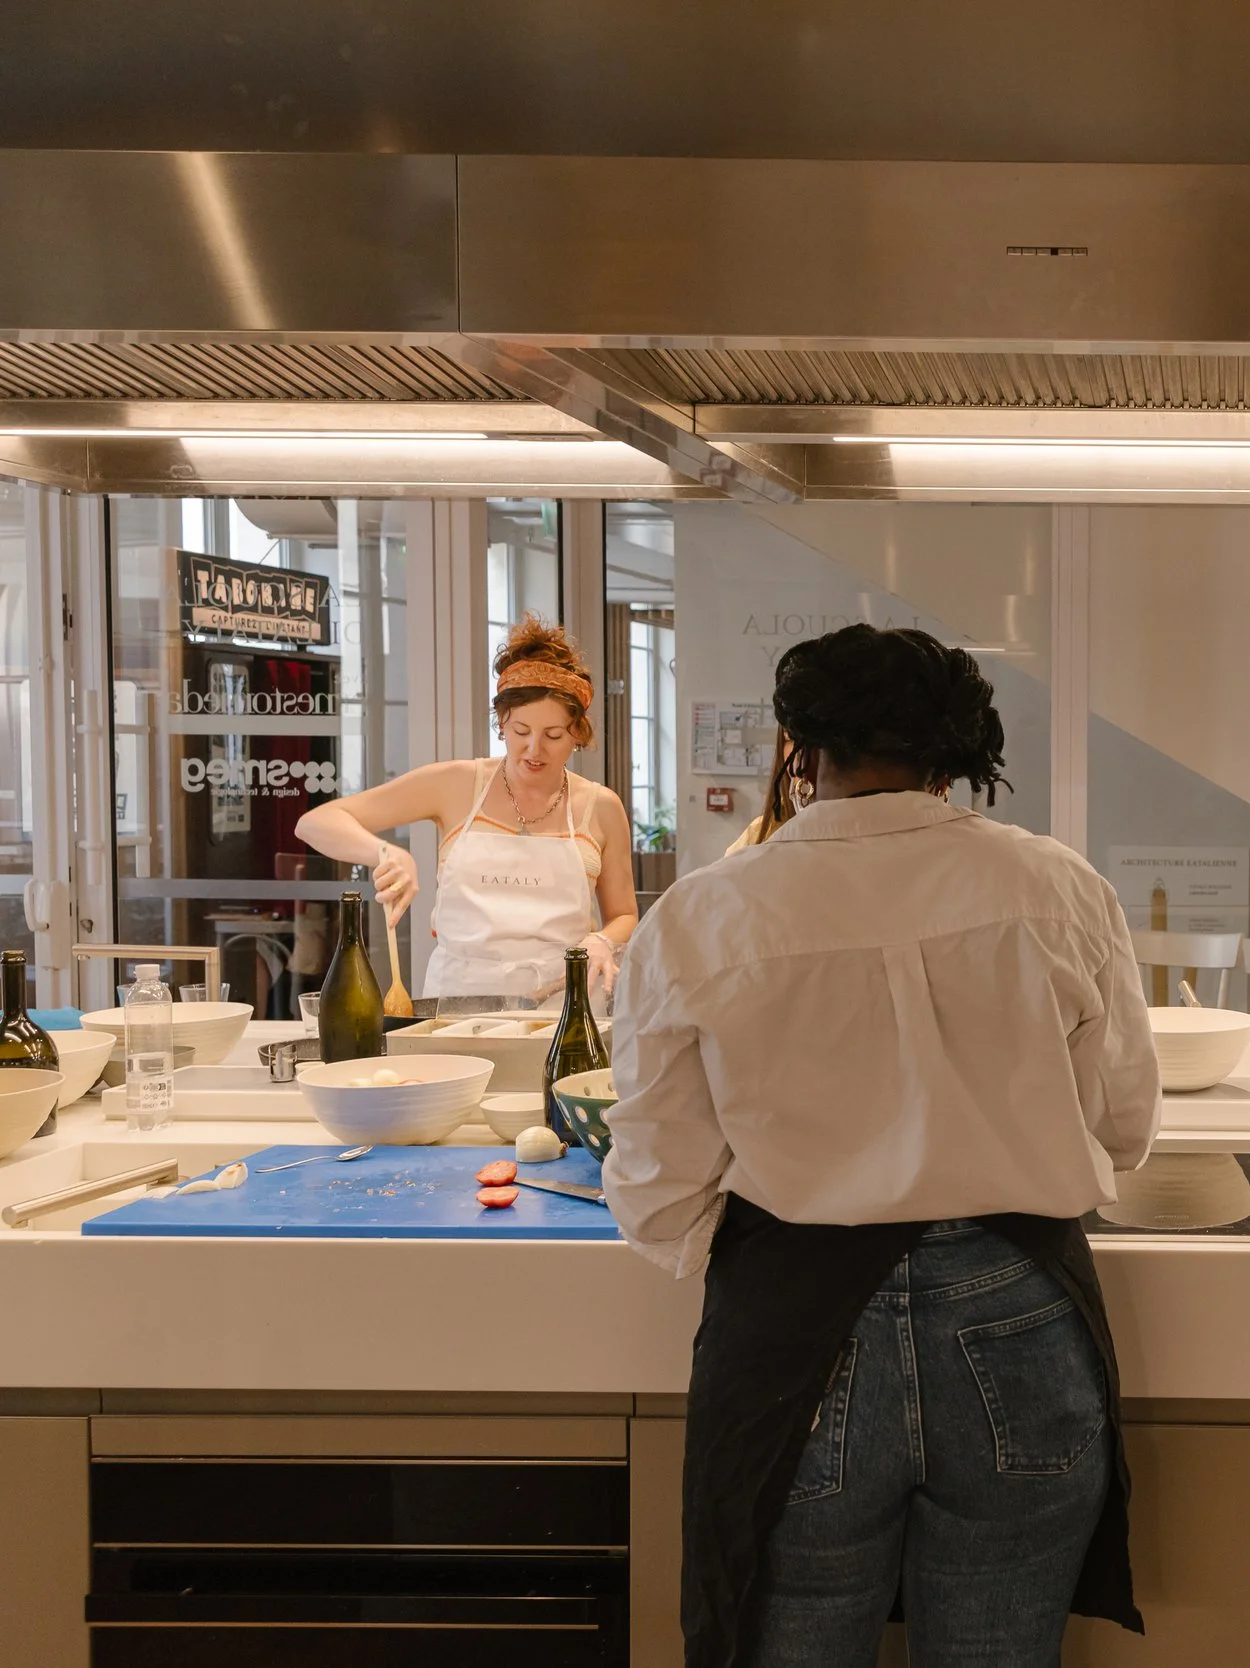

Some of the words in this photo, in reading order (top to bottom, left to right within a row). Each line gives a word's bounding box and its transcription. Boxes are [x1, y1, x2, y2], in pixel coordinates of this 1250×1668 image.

[212, 613, 257, 630] CAPTUREZ
[1120, 859, 1184, 868] ARCHITECTURE
[1186, 859, 1238, 868] EATALIENNE
[481, 875, 541, 886] EATALY
